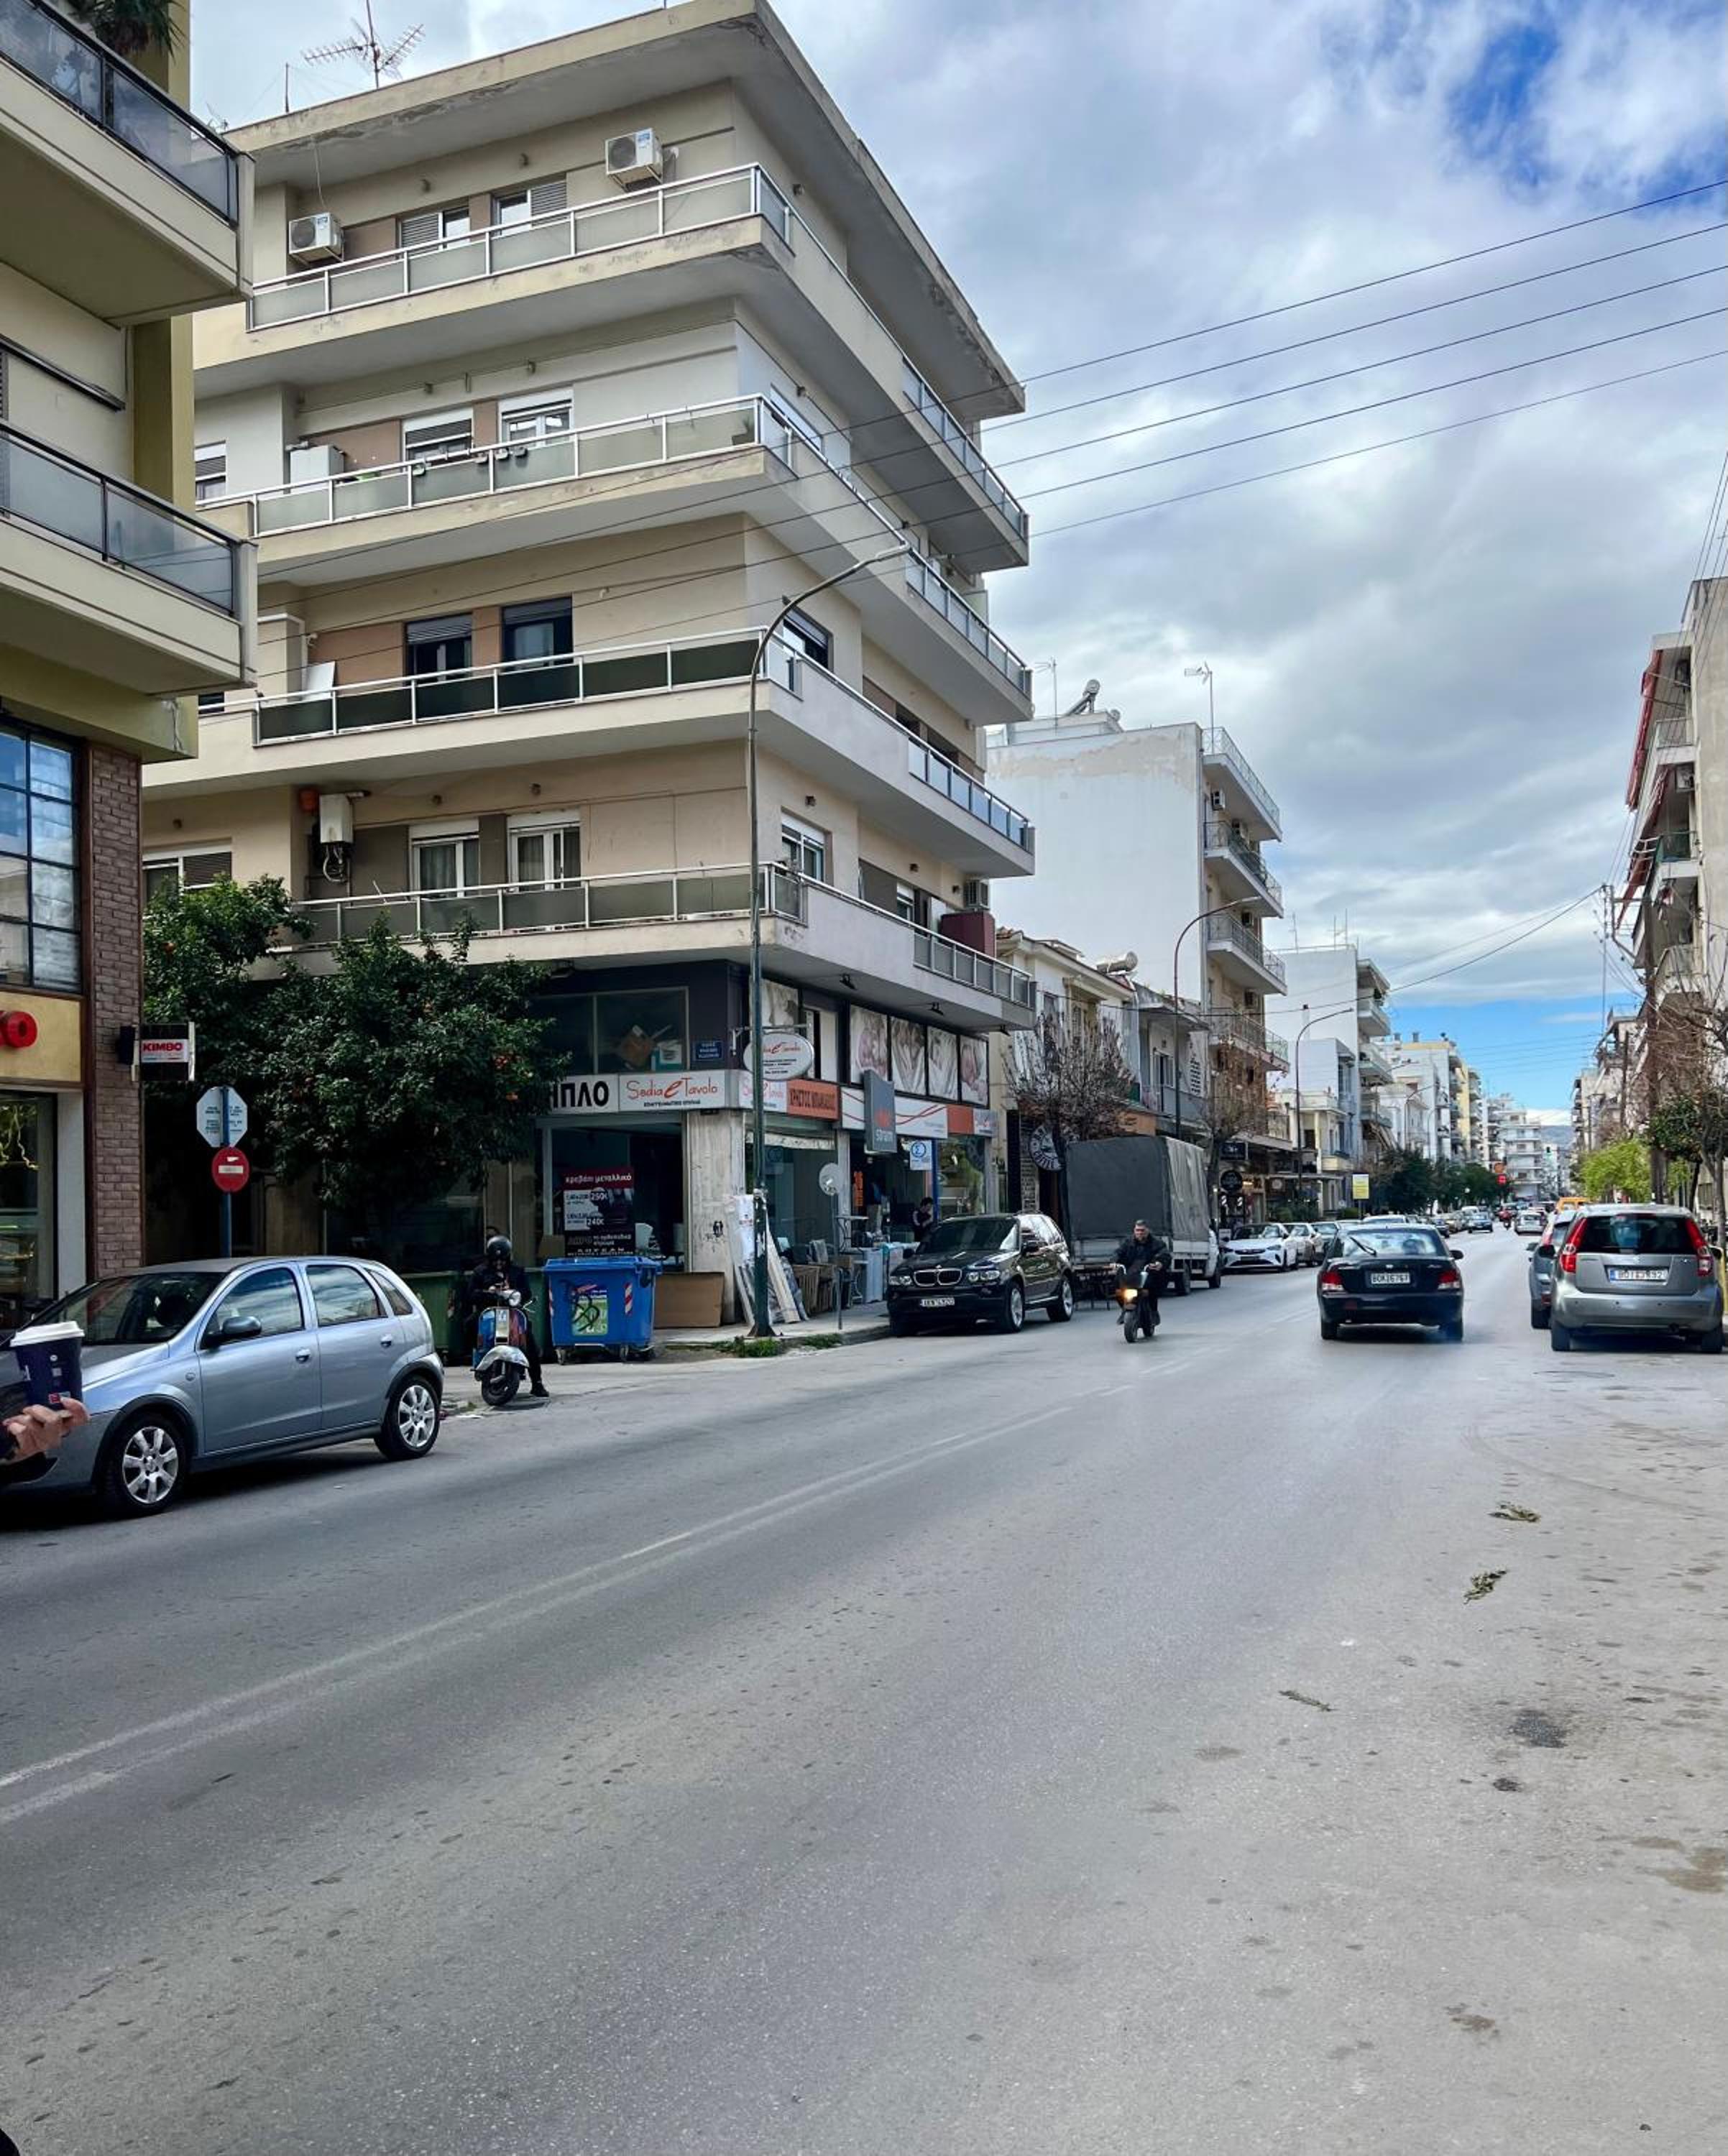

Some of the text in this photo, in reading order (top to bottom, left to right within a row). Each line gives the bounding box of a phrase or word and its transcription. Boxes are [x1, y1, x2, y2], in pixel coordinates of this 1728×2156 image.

[143, 1042, 183, 1051] KIMBO
[626, 1079, 663, 1100] Sedia
[681, 1077, 718, 1097] Tavolo
